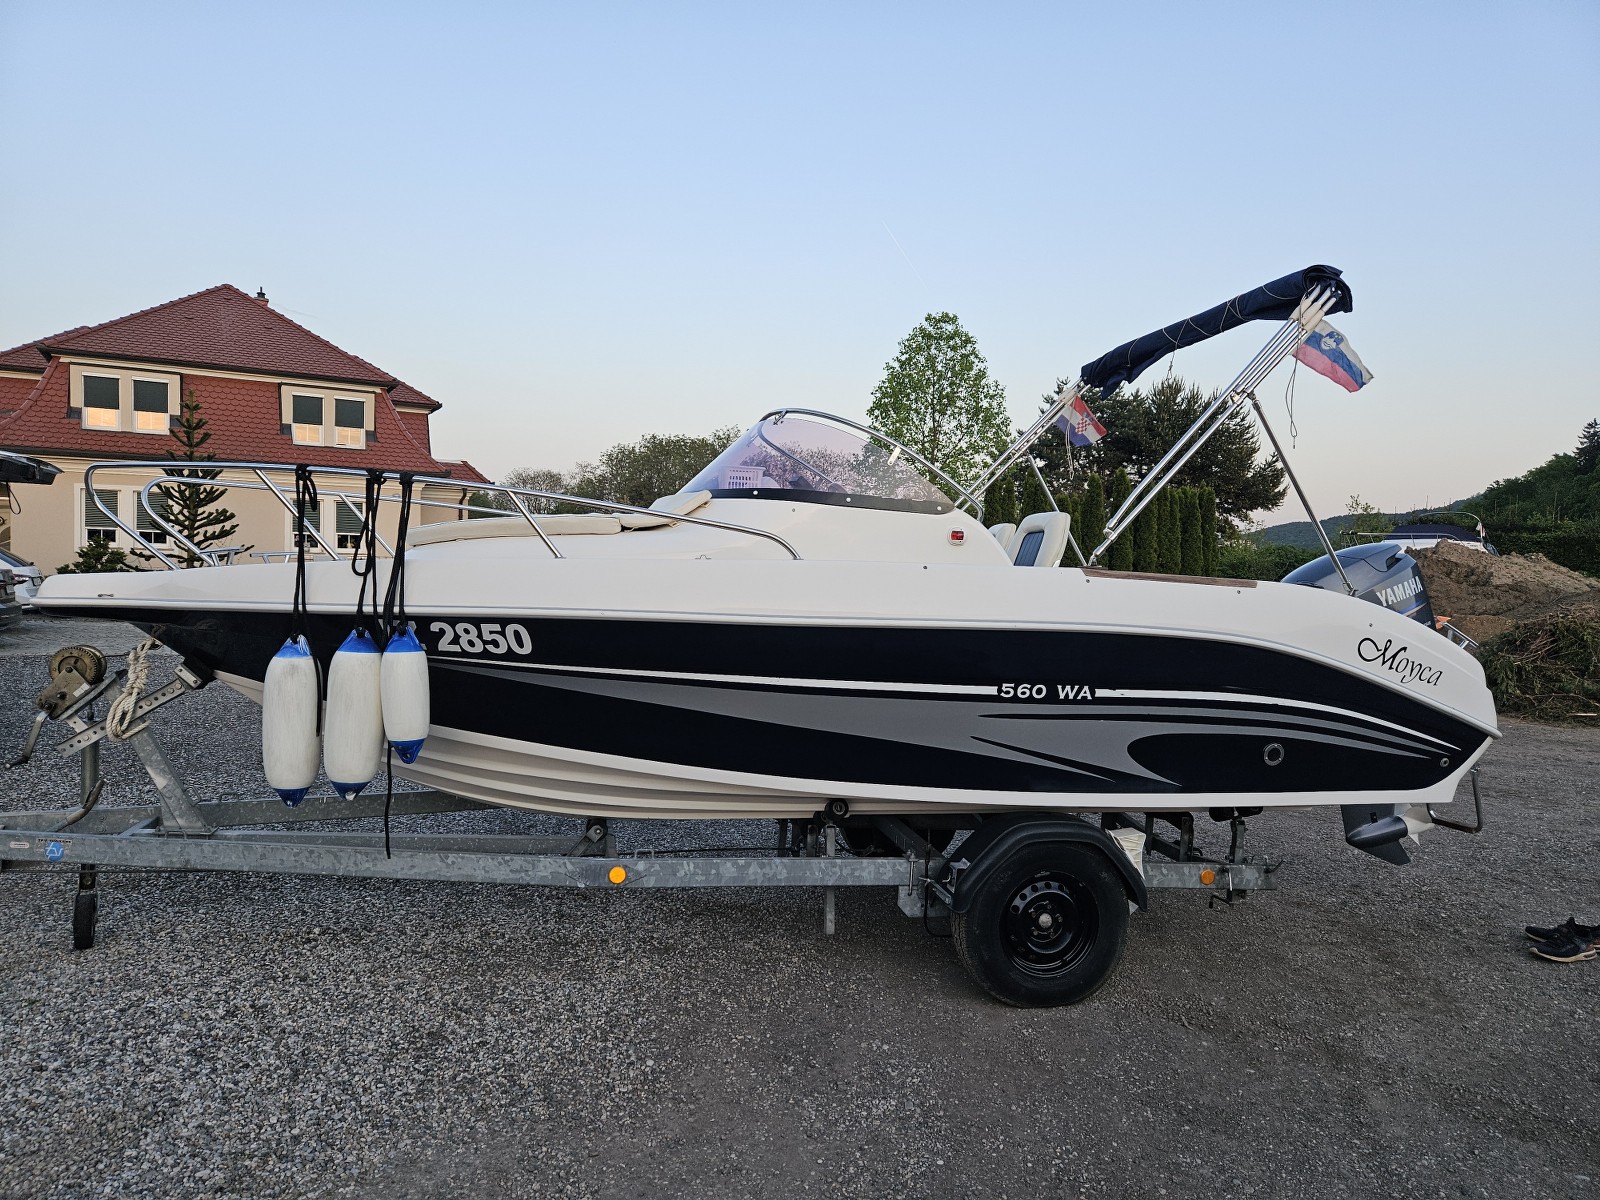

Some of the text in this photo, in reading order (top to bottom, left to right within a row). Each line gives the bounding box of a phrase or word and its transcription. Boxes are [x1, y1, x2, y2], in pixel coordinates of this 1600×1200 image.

[1376, 575, 1424, 607] YAMAHA
[429, 621, 533, 655] 2850
[1357, 637, 1443, 686] Moyca
[1000, 683, 1092, 700] 560 WA
